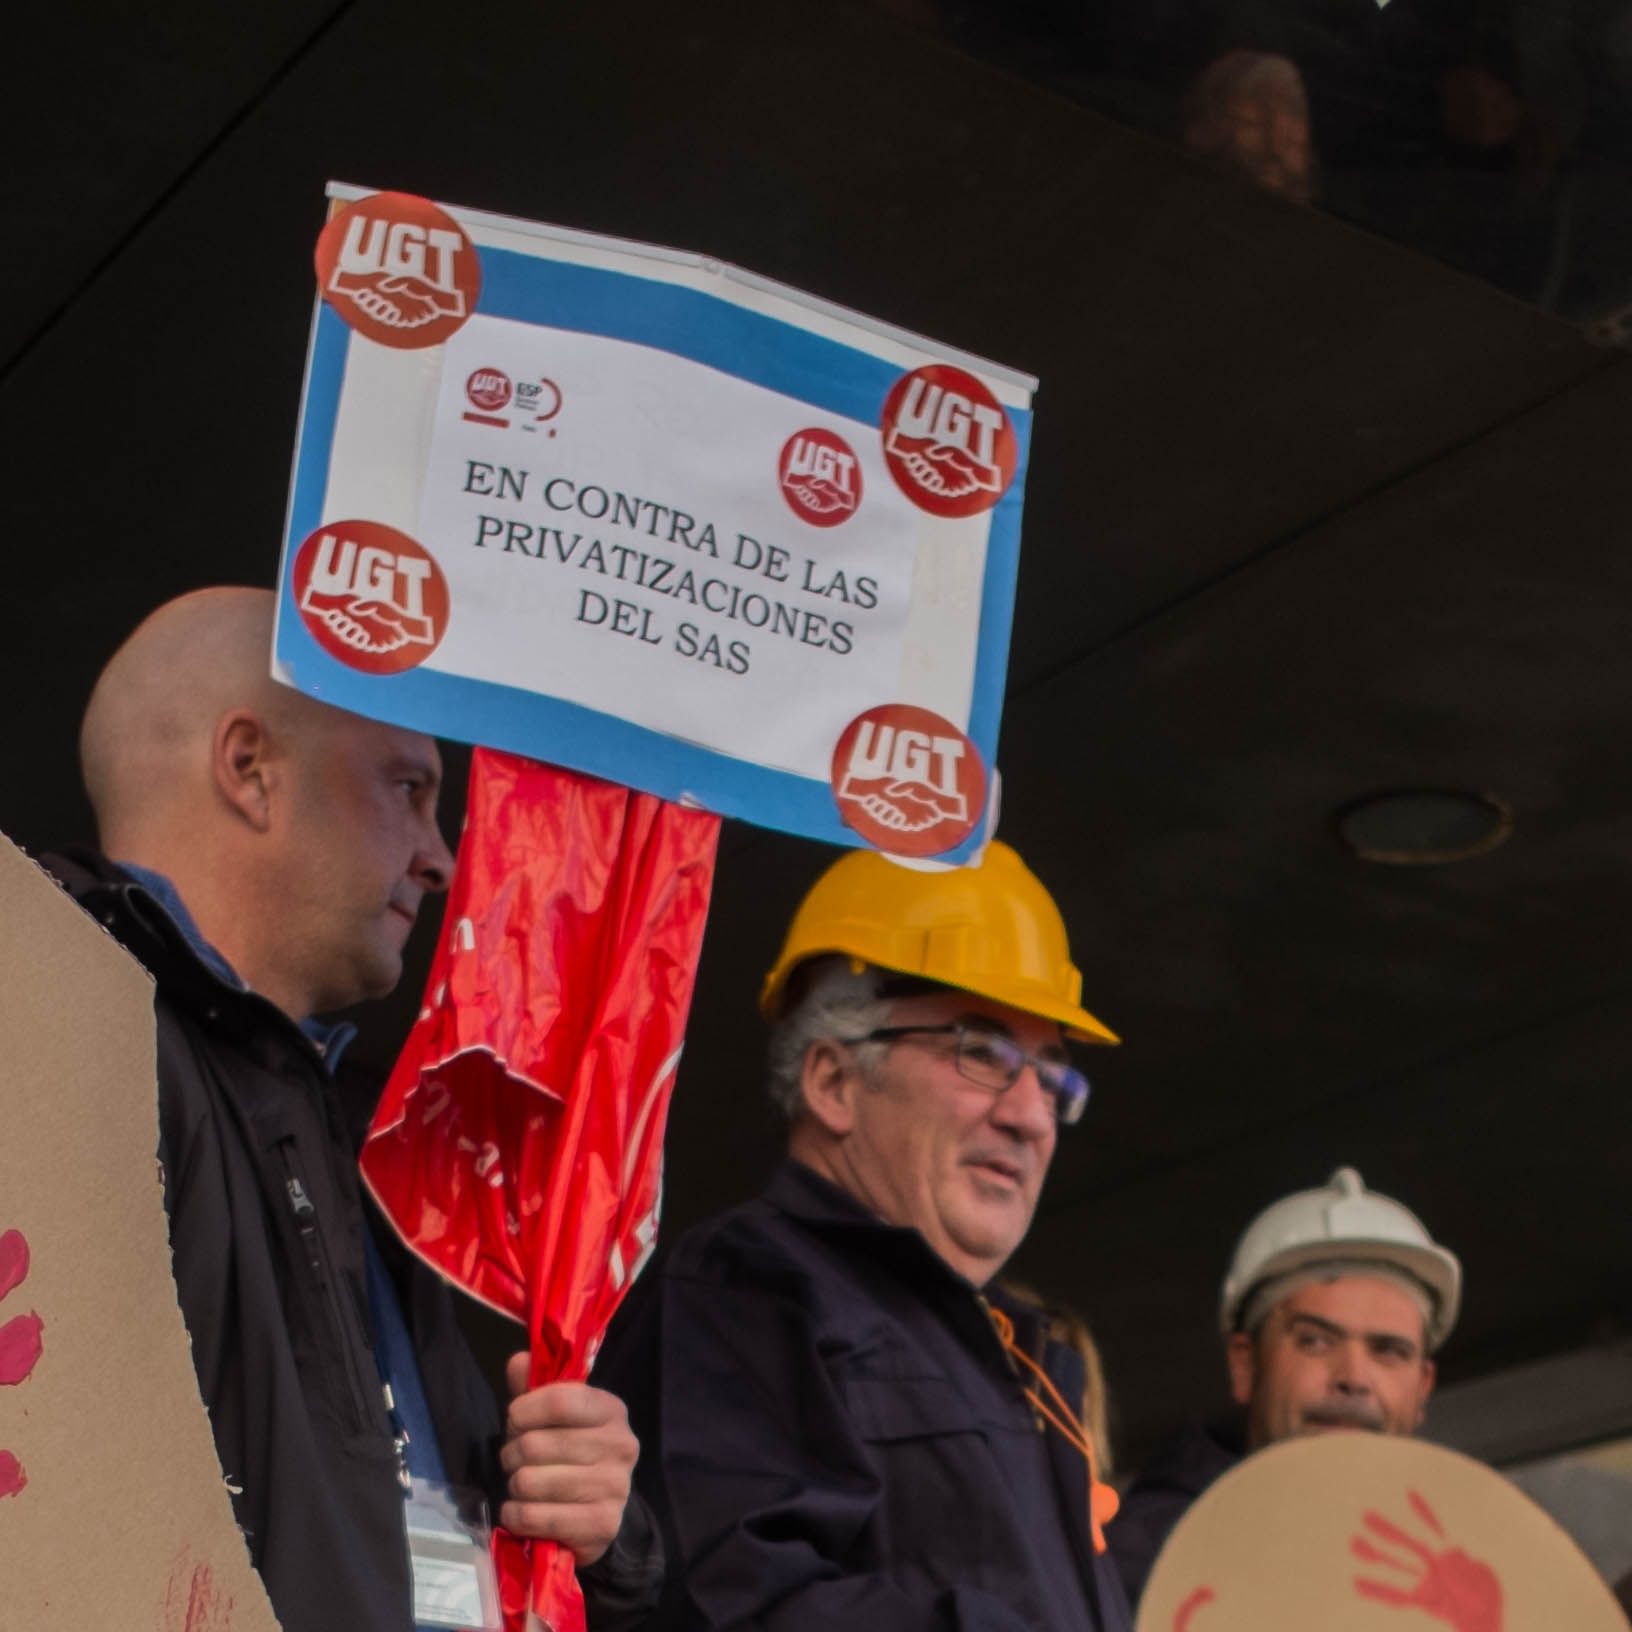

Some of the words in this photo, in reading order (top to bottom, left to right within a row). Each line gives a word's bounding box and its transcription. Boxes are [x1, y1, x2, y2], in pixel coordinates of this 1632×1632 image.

[343, 214, 462, 288] UGT
[906, 377, 1003, 460] UGT
[790, 436, 855, 490] UGT
[313, 535, 432, 612] UGT
[461, 459, 529, 502] EN
[543, 476, 720, 558] CONTRA
[732, 533, 791, 583] DE
[800, 559, 879, 609] LAS
[473, 513, 854, 655] PRIVATIZACIONES
[575, 588, 664, 646] DEL
[675, 622, 751, 676] SAS
[855, 721, 964, 794] UGT
